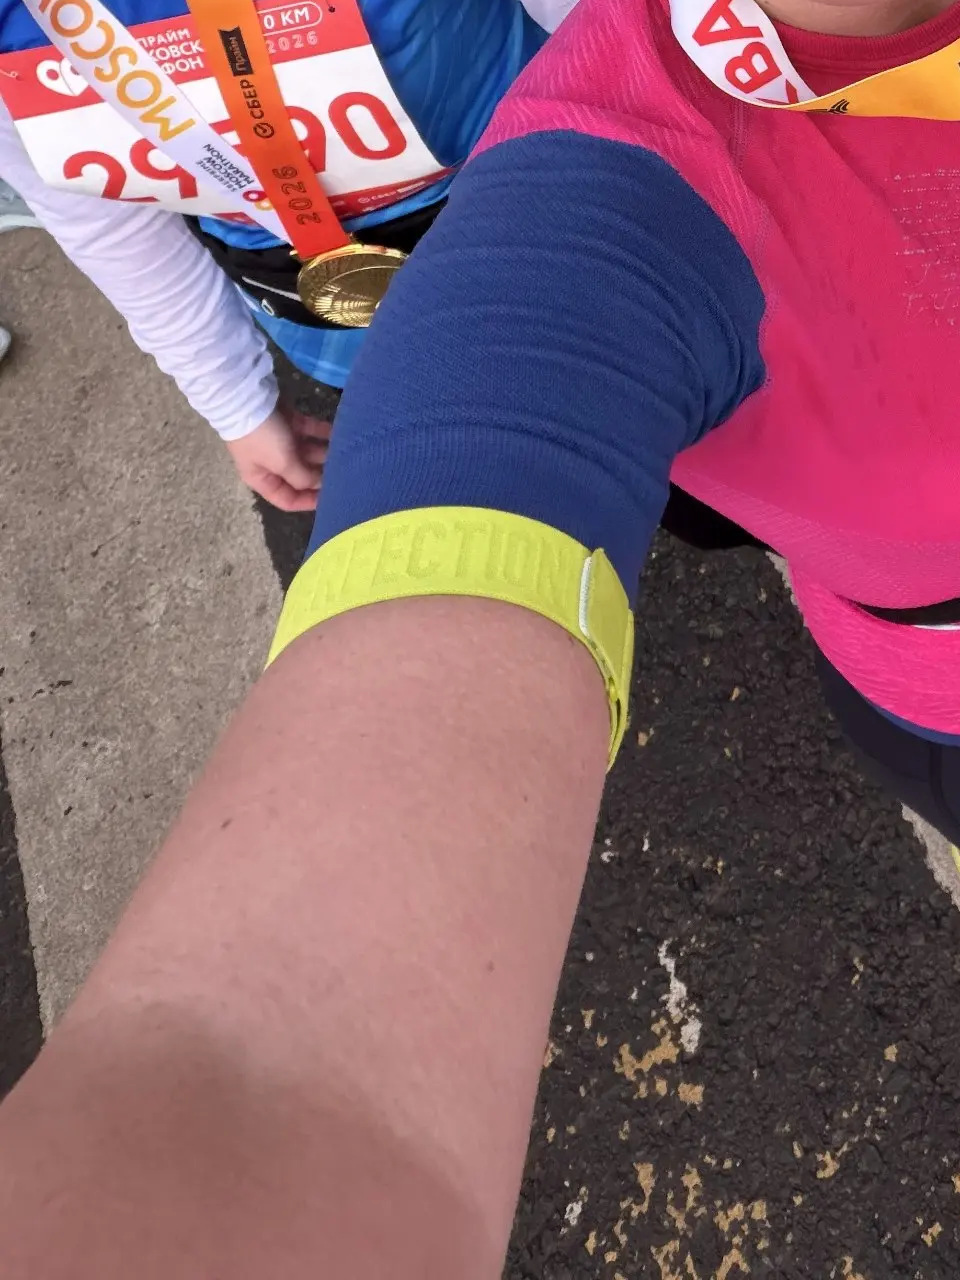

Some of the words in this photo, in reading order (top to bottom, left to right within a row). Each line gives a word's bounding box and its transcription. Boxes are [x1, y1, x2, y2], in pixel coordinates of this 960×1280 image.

[262, 14, 276, 30] 0
[281, 7, 310, 27] КМ
[240, 78, 265, 120] СБЕР
[63, 91, 408, 203] 2990
[203, 143, 256, 186] MARATHON
[202, 156, 249, 189] MOSCOW
[272, 165, 322, 226] 2026
